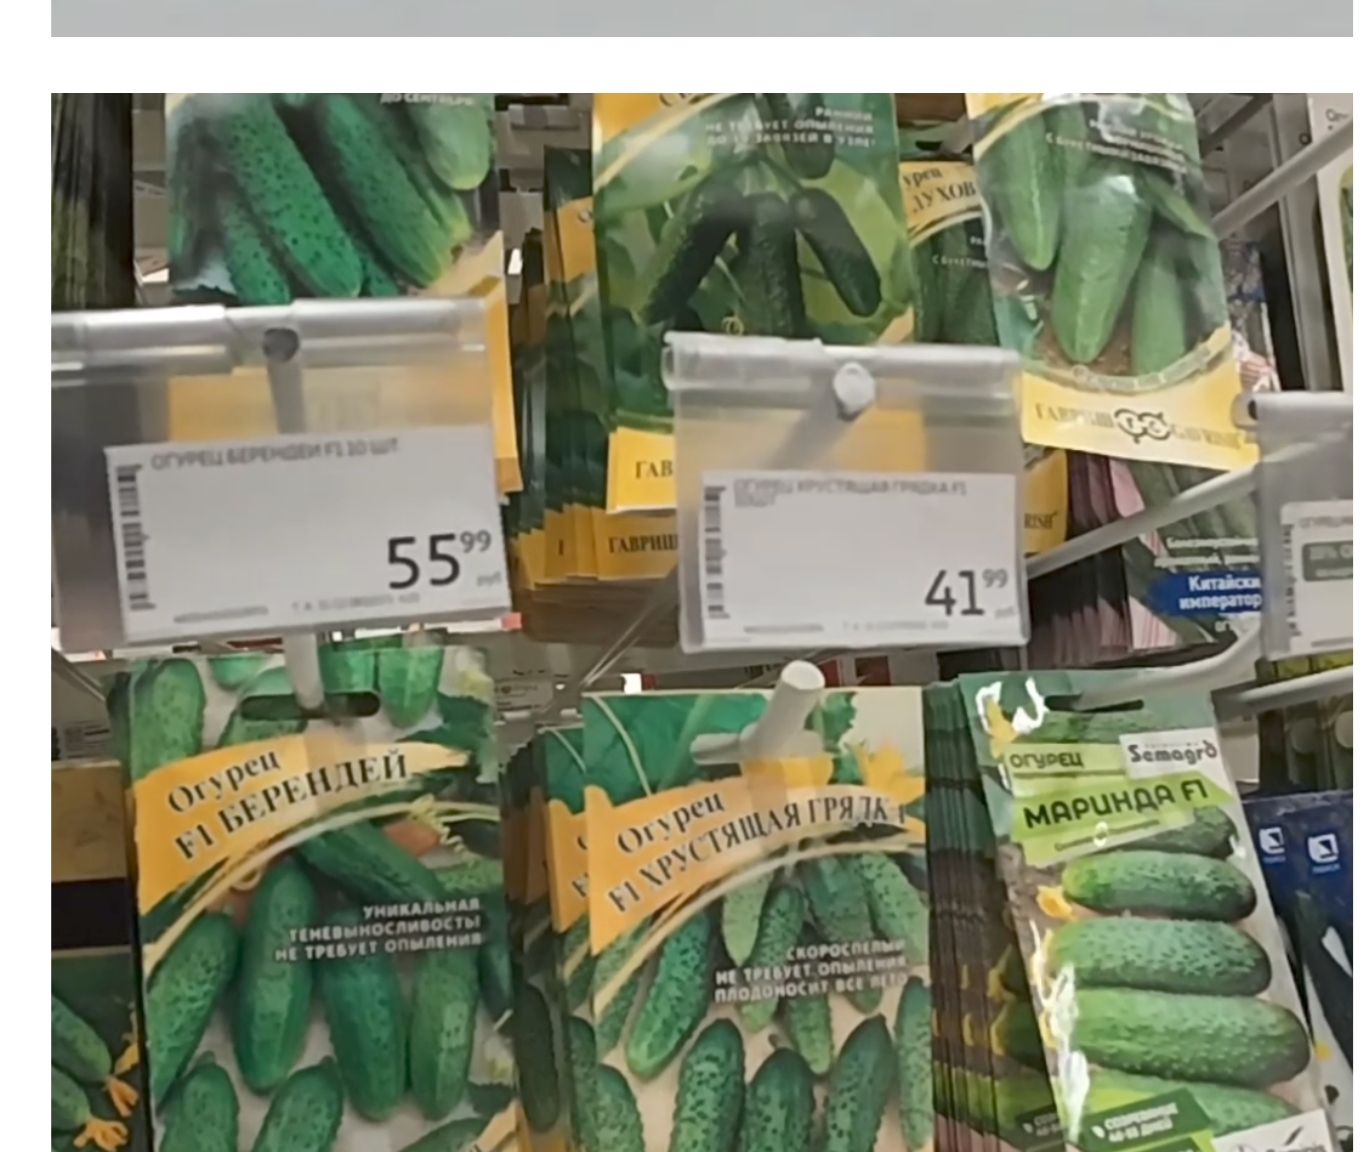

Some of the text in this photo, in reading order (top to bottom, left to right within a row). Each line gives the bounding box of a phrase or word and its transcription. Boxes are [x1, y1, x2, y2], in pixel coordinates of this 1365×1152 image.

[1010, 751, 1085, 770] ОГУРЕЦ
[167, 749, 282, 814] Огурец
[174, 747, 408, 860] F1 БЕРЕНДЕЙ
[617, 791, 725, 855] Огурец
[1023, 779, 1210, 830] МАРИНДА F1
[608, 880, 641, 914] F1
[639, 802, 802, 890] ХРУСТЯЩАЯ
[362, 897, 481, 921] УНИКАЛЬНАЯ
[275, 932, 482, 962] НЕ ТРЕБУЕТ ОПЫЛЕНИЯ
[715, 981, 829, 1003] ПЛОДОНОСИТ
[834, 977, 865, 993] ВСЕ
[716, 955, 908, 986] НЕ ТРЕБУЕТ ОПЫЛЕНИЯ
